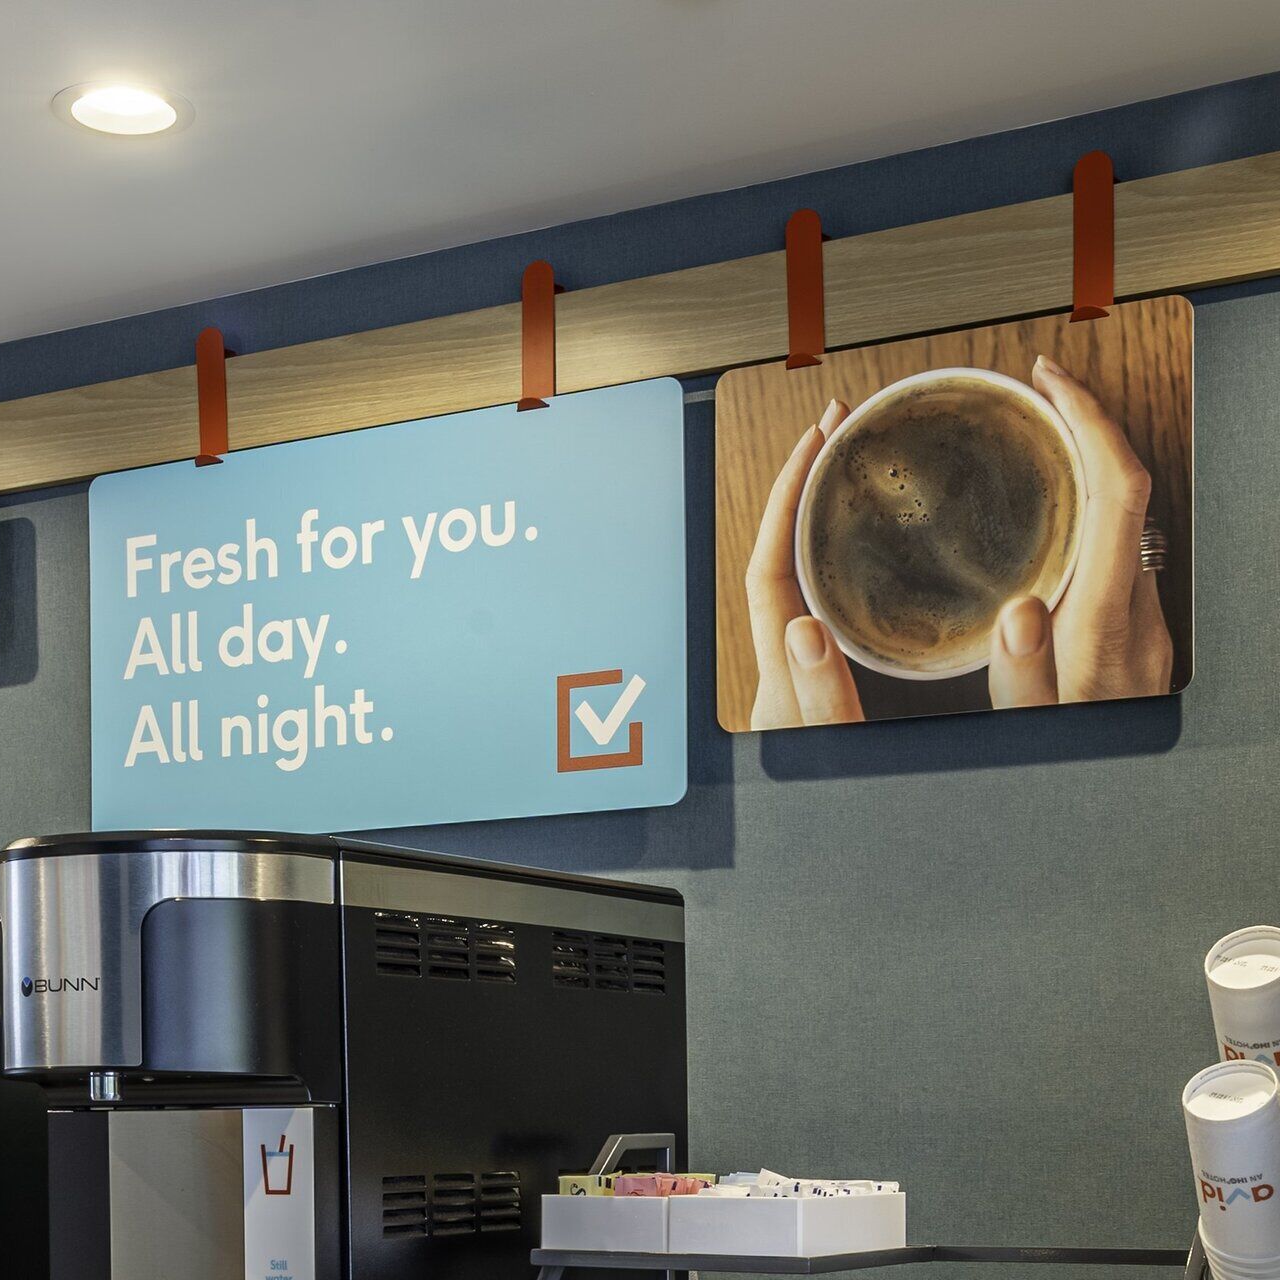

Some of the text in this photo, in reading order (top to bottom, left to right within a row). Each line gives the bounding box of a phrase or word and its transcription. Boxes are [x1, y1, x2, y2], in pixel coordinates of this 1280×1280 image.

[125, 500, 538, 598] Fresh for you.
[123, 603, 348, 680] All day.
[123, 684, 394, 772] All night.
[34, 977, 99, 993] BUNN
[270, 1260, 288, 1271] Still
